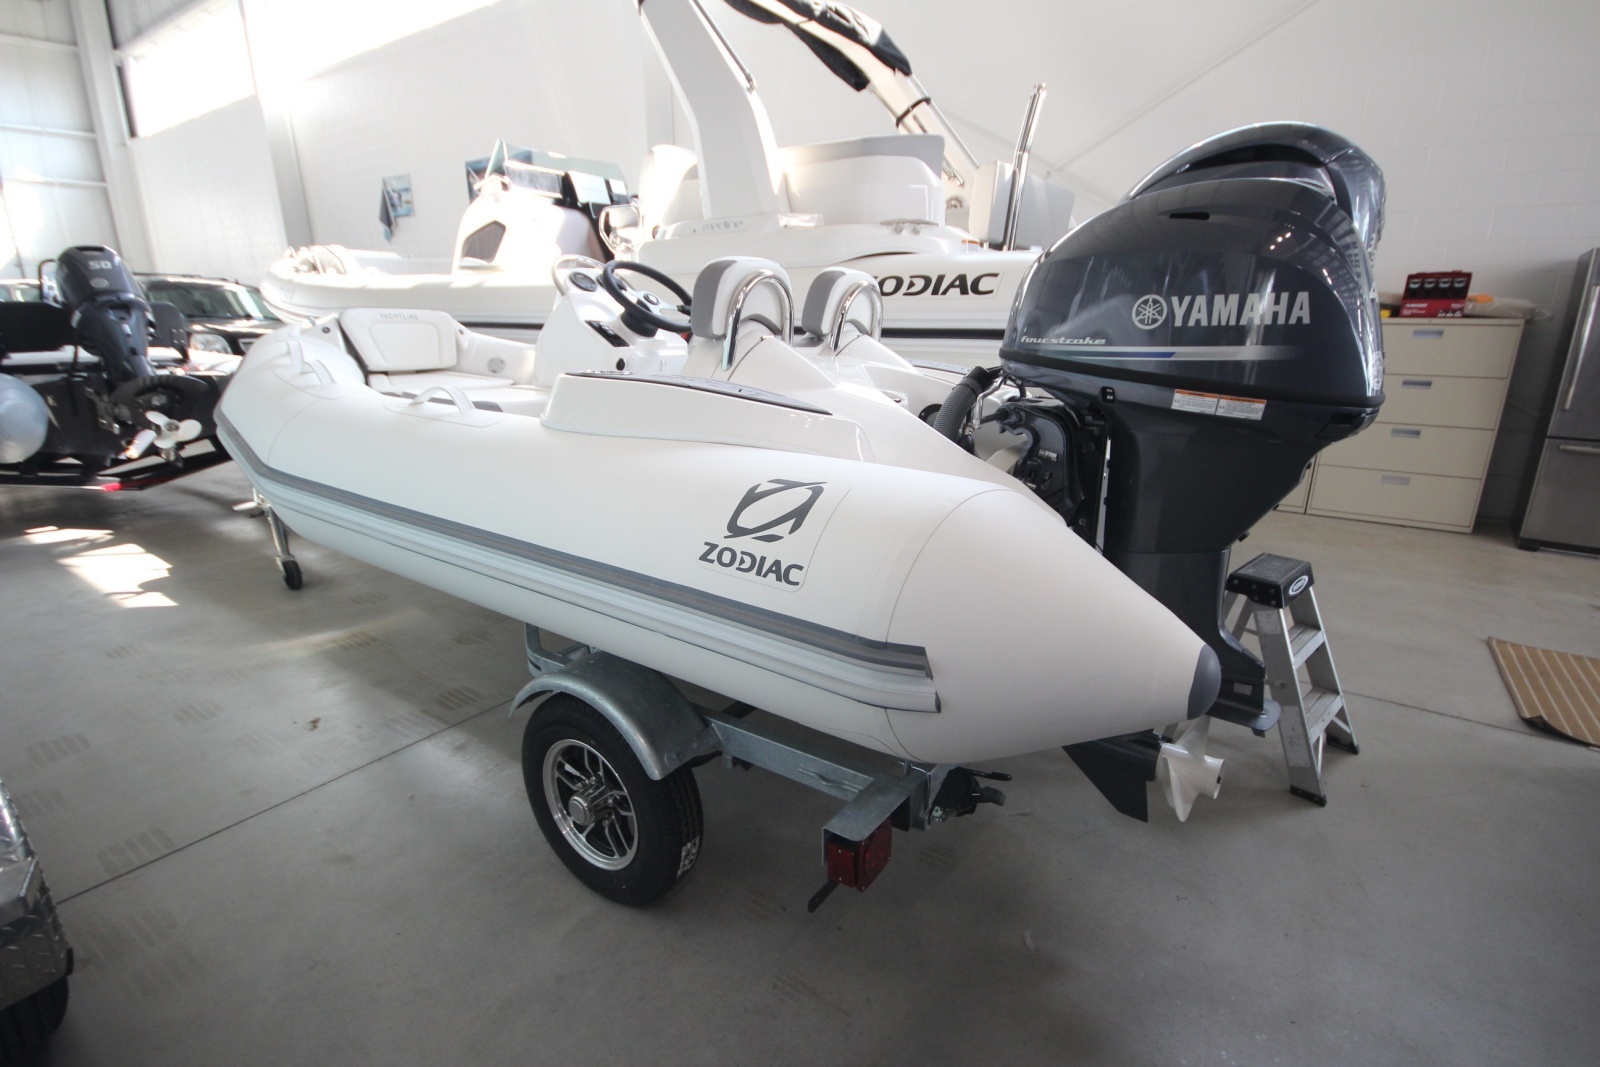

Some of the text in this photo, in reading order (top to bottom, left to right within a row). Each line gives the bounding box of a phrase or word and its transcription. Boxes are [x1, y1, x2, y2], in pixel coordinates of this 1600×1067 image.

[88, 260, 112, 270] 50
[874, 272, 1000, 297] ODIAC
[379, 312, 419, 320] YACHTLINE
[1171, 291, 1311, 327] YAMAHA
[698, 541, 804, 586] ZODIAC
